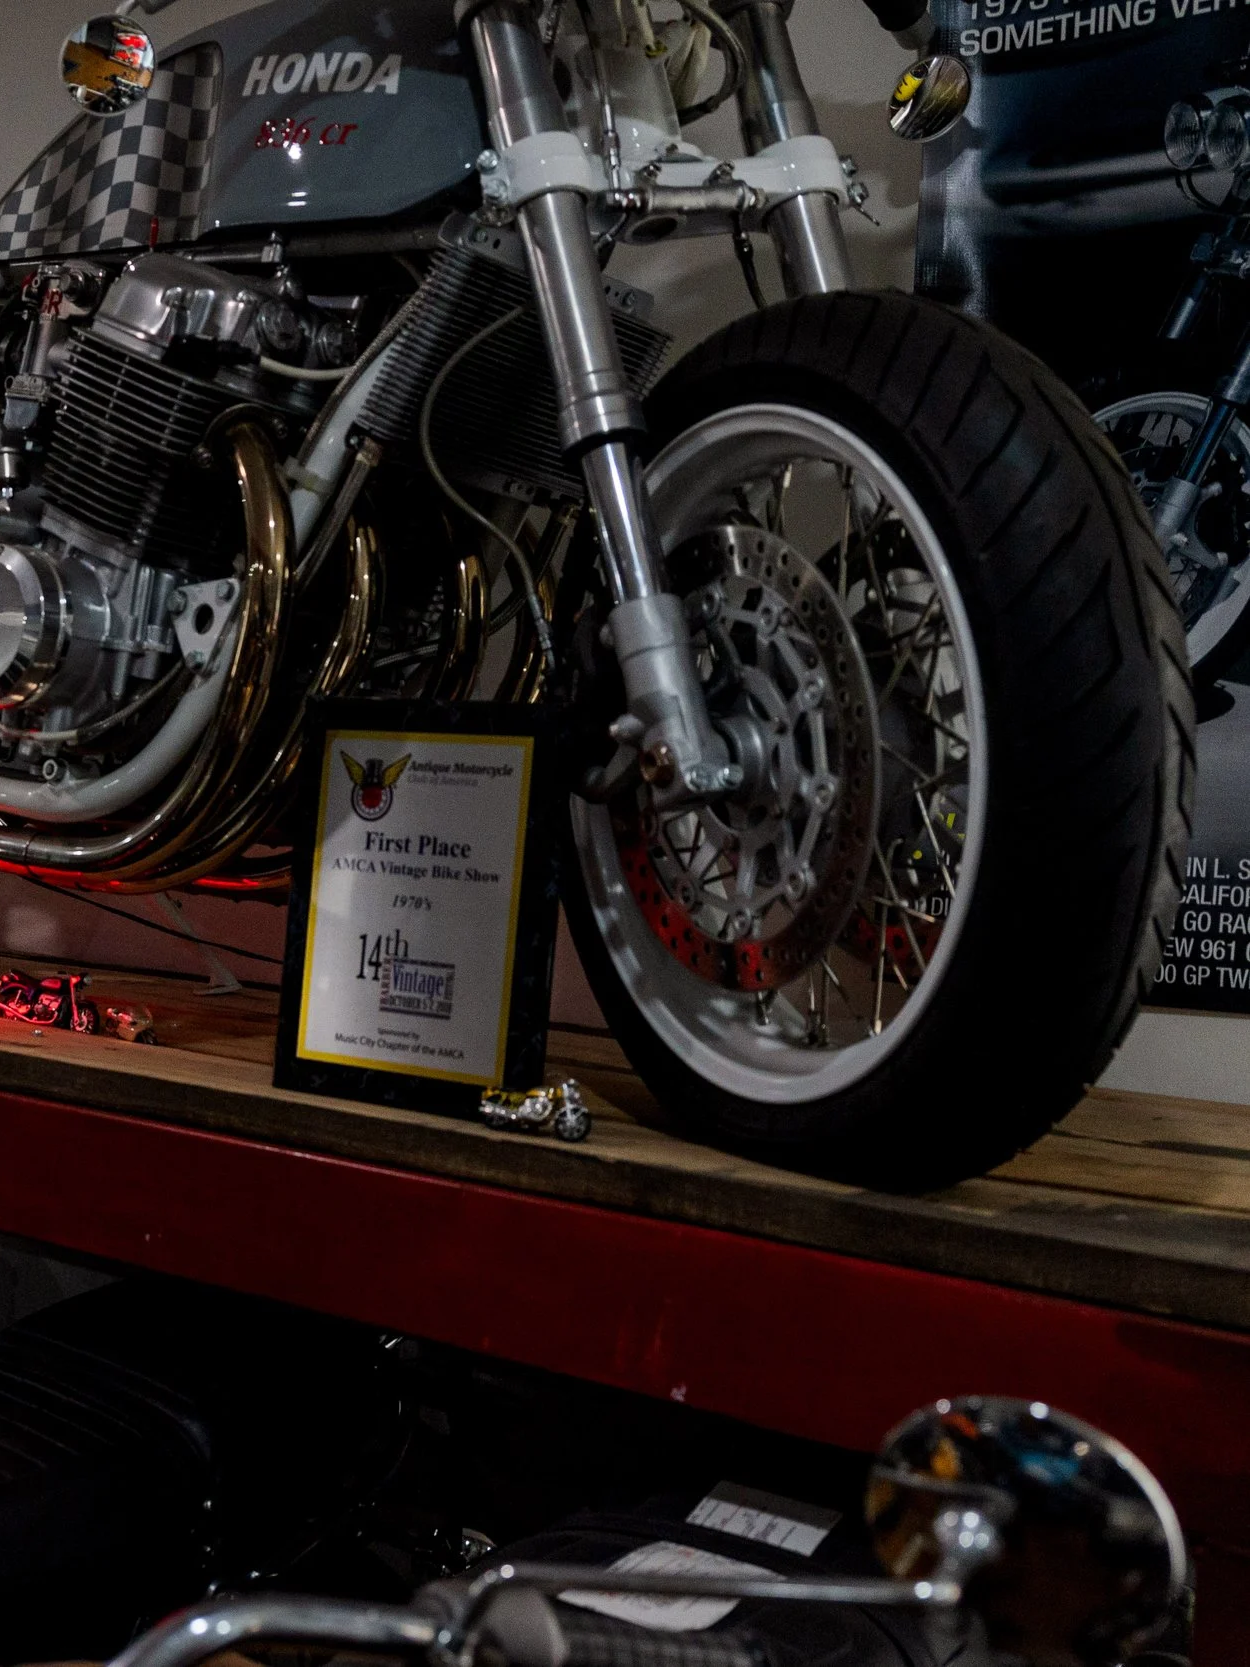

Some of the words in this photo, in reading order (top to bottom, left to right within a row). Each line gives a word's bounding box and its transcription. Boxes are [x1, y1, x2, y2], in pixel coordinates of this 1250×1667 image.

[959, 0, 1156, 57] SOMETHING
[241, 51, 402, 97] HONDA
[409, 760, 451, 775] Antique
[452, 762, 514, 778] Motorcycle
[364, 830, 412, 855] First
[418, 834, 472, 859] Place
[331, 857, 377, 874] AMCA
[379, 860, 429, 880] Vintage
[431, 864, 461, 881] Bike
[463, 868, 500, 884] Show
[1182, 910, 1212, 933] GO
[1218, 912, 1250, 934] RA
[1199, 939, 1236, 962] 961
[392, 963, 445, 999] Vintage
[1183, 964, 1210, 986] GP
[334, 1031, 358, 1045] Music
[359, 1035, 376, 1049] City
[376, 1038, 410, 1052] Chapter
[410, 1044, 421, 1053] of
[437, 1047, 465, 1060] AMCA
